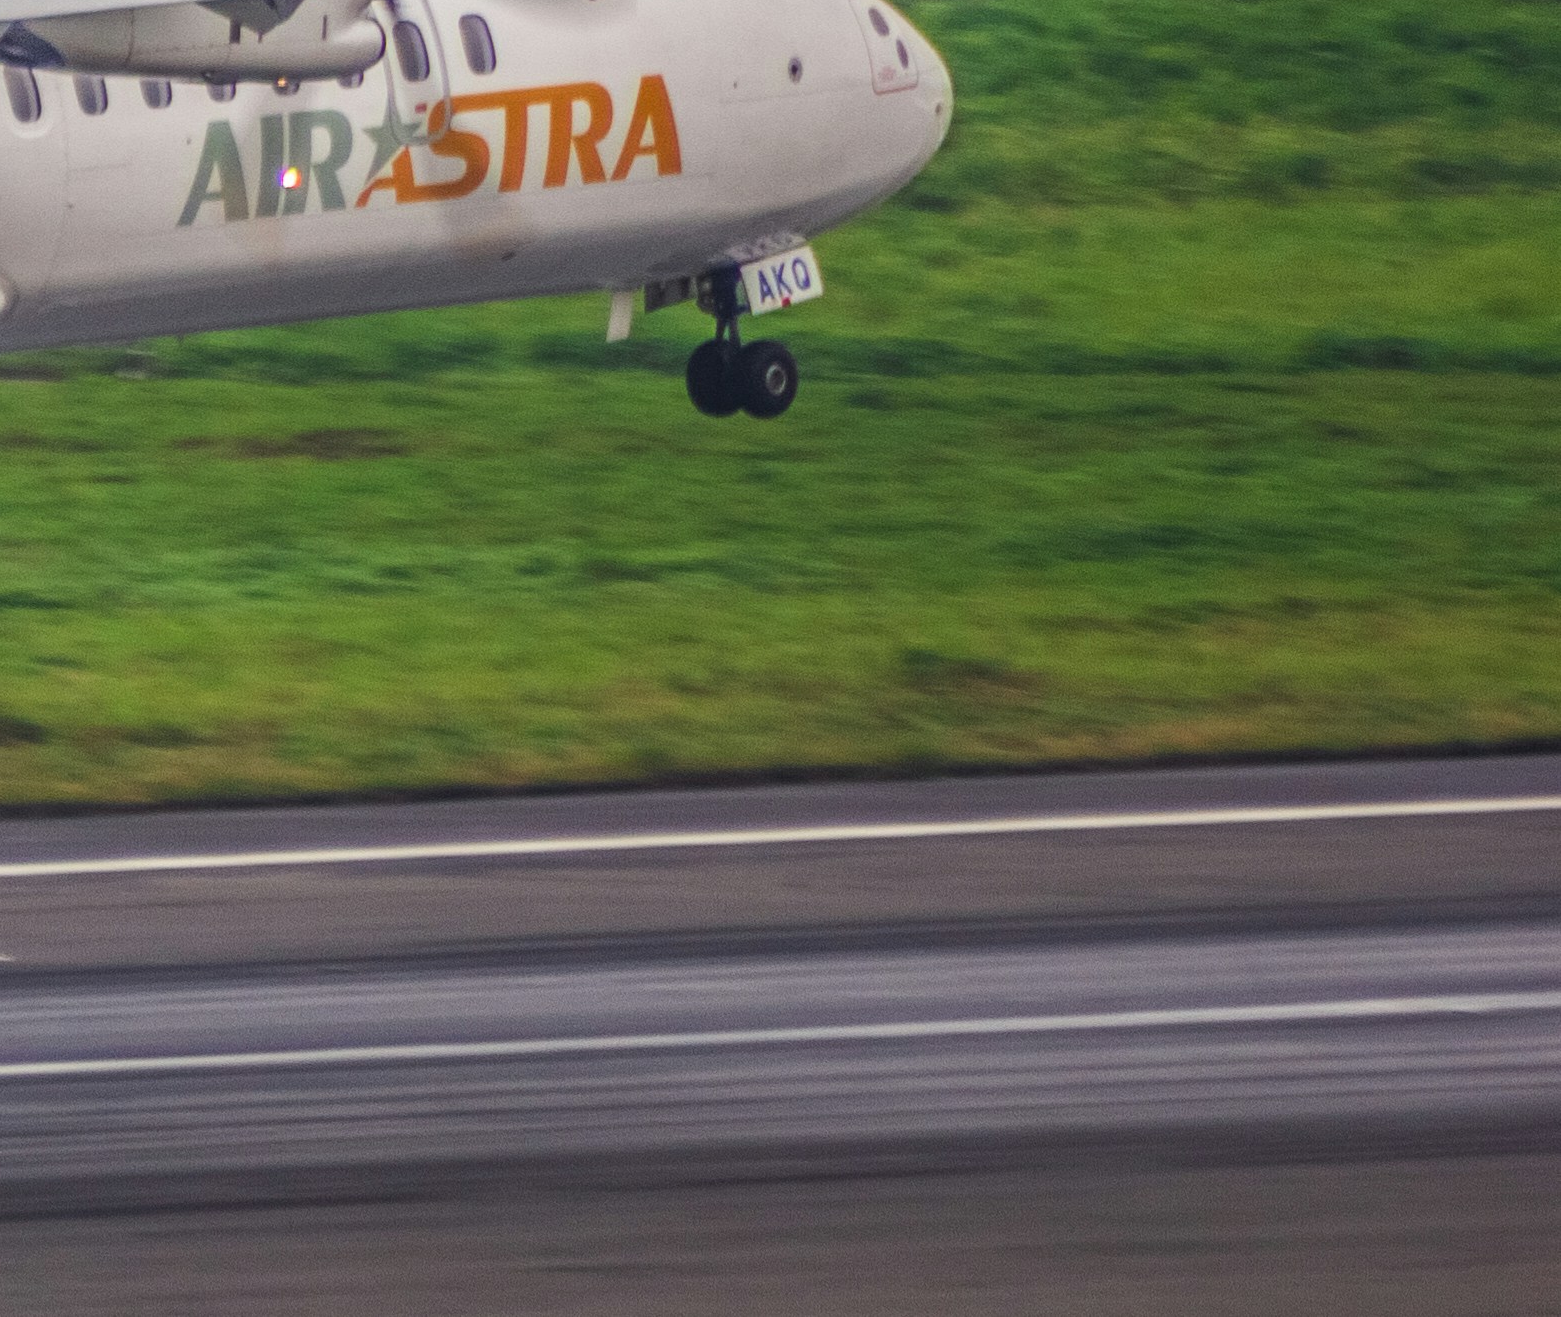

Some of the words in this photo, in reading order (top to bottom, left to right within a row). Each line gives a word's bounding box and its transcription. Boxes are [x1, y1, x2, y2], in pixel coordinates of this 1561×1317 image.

[178, 110, 353, 226] AIR
[354, 73, 682, 209] ASTRA
[757, 256, 811, 304] AKQ
